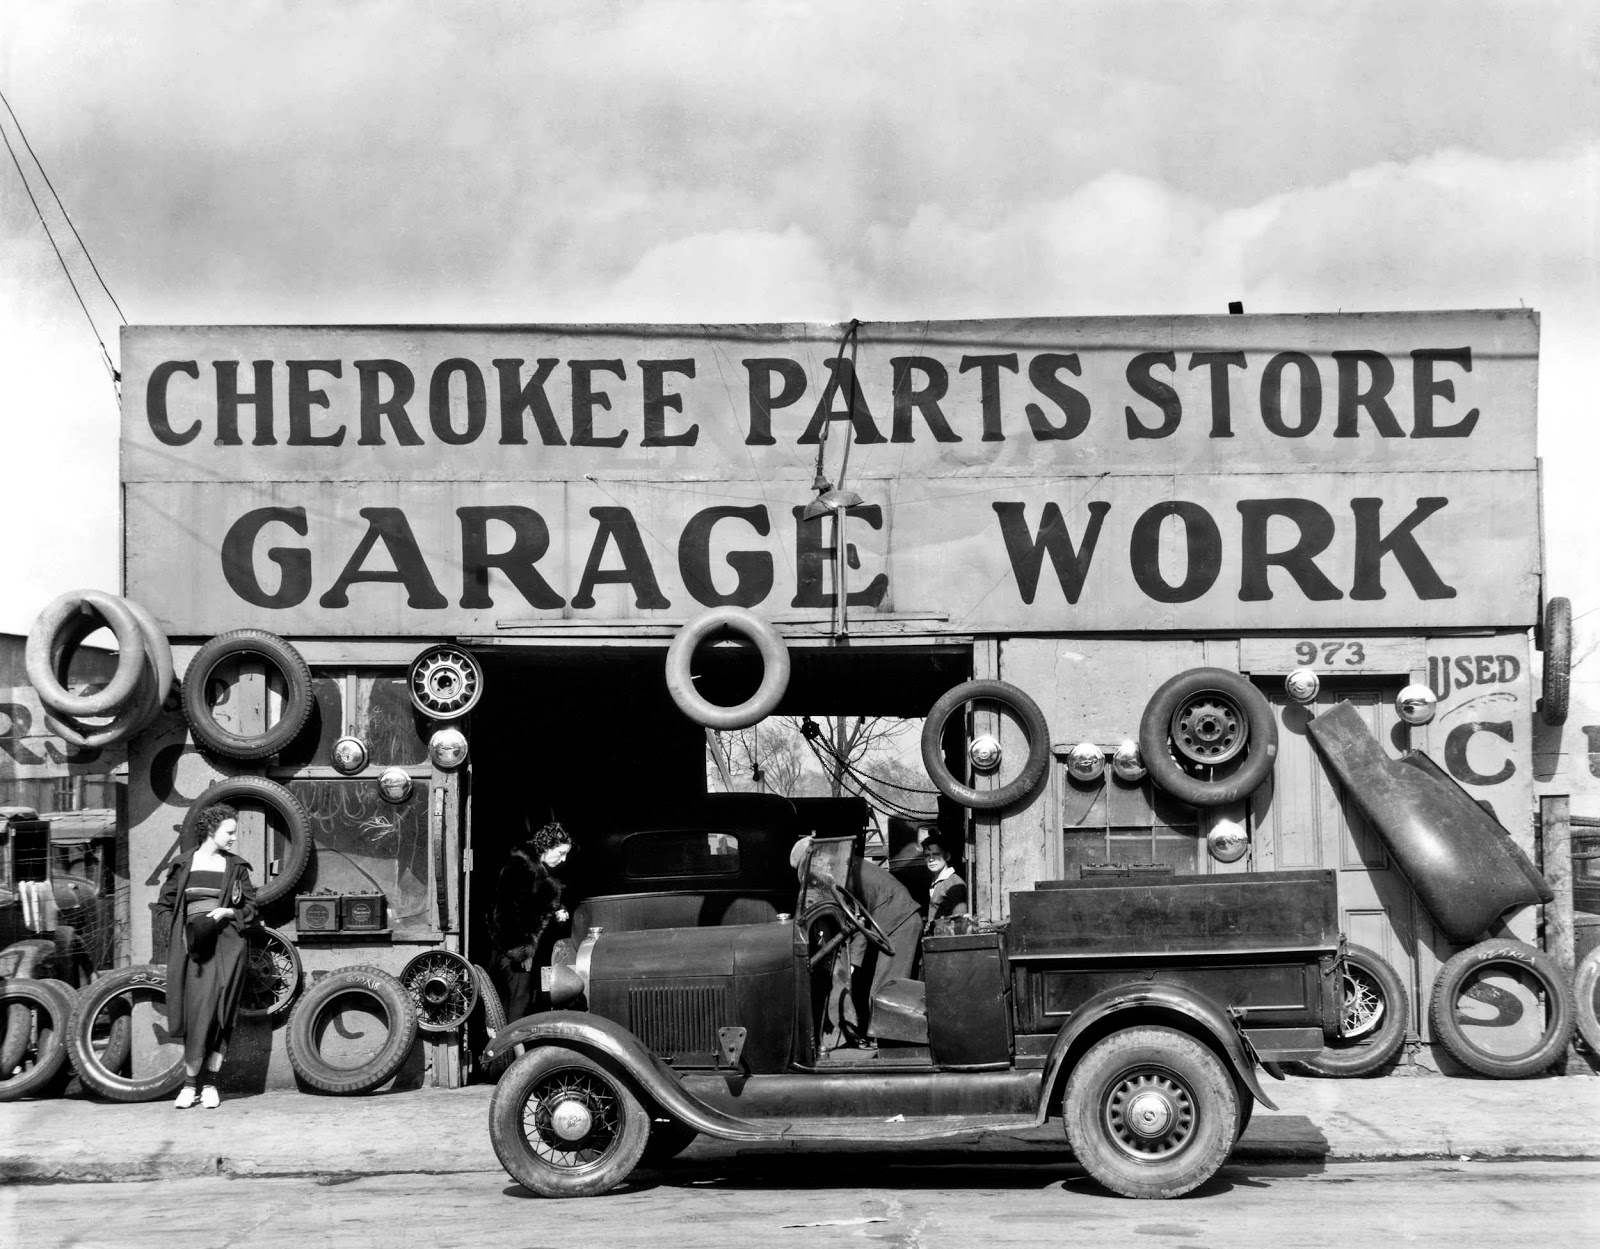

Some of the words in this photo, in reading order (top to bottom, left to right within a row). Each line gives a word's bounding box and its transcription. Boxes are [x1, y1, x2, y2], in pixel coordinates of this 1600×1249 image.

[146, 357, 700, 449] CHEROKEE
[741, 352, 1092, 446] PARTS
[1124, 345, 1481, 440] STORE
[221, 502, 889, 610] GARAGE
[991, 496, 1458, 605] WORK
[1295, 641, 1366, 666] 973
[1428, 654, 1521, 702] USED
